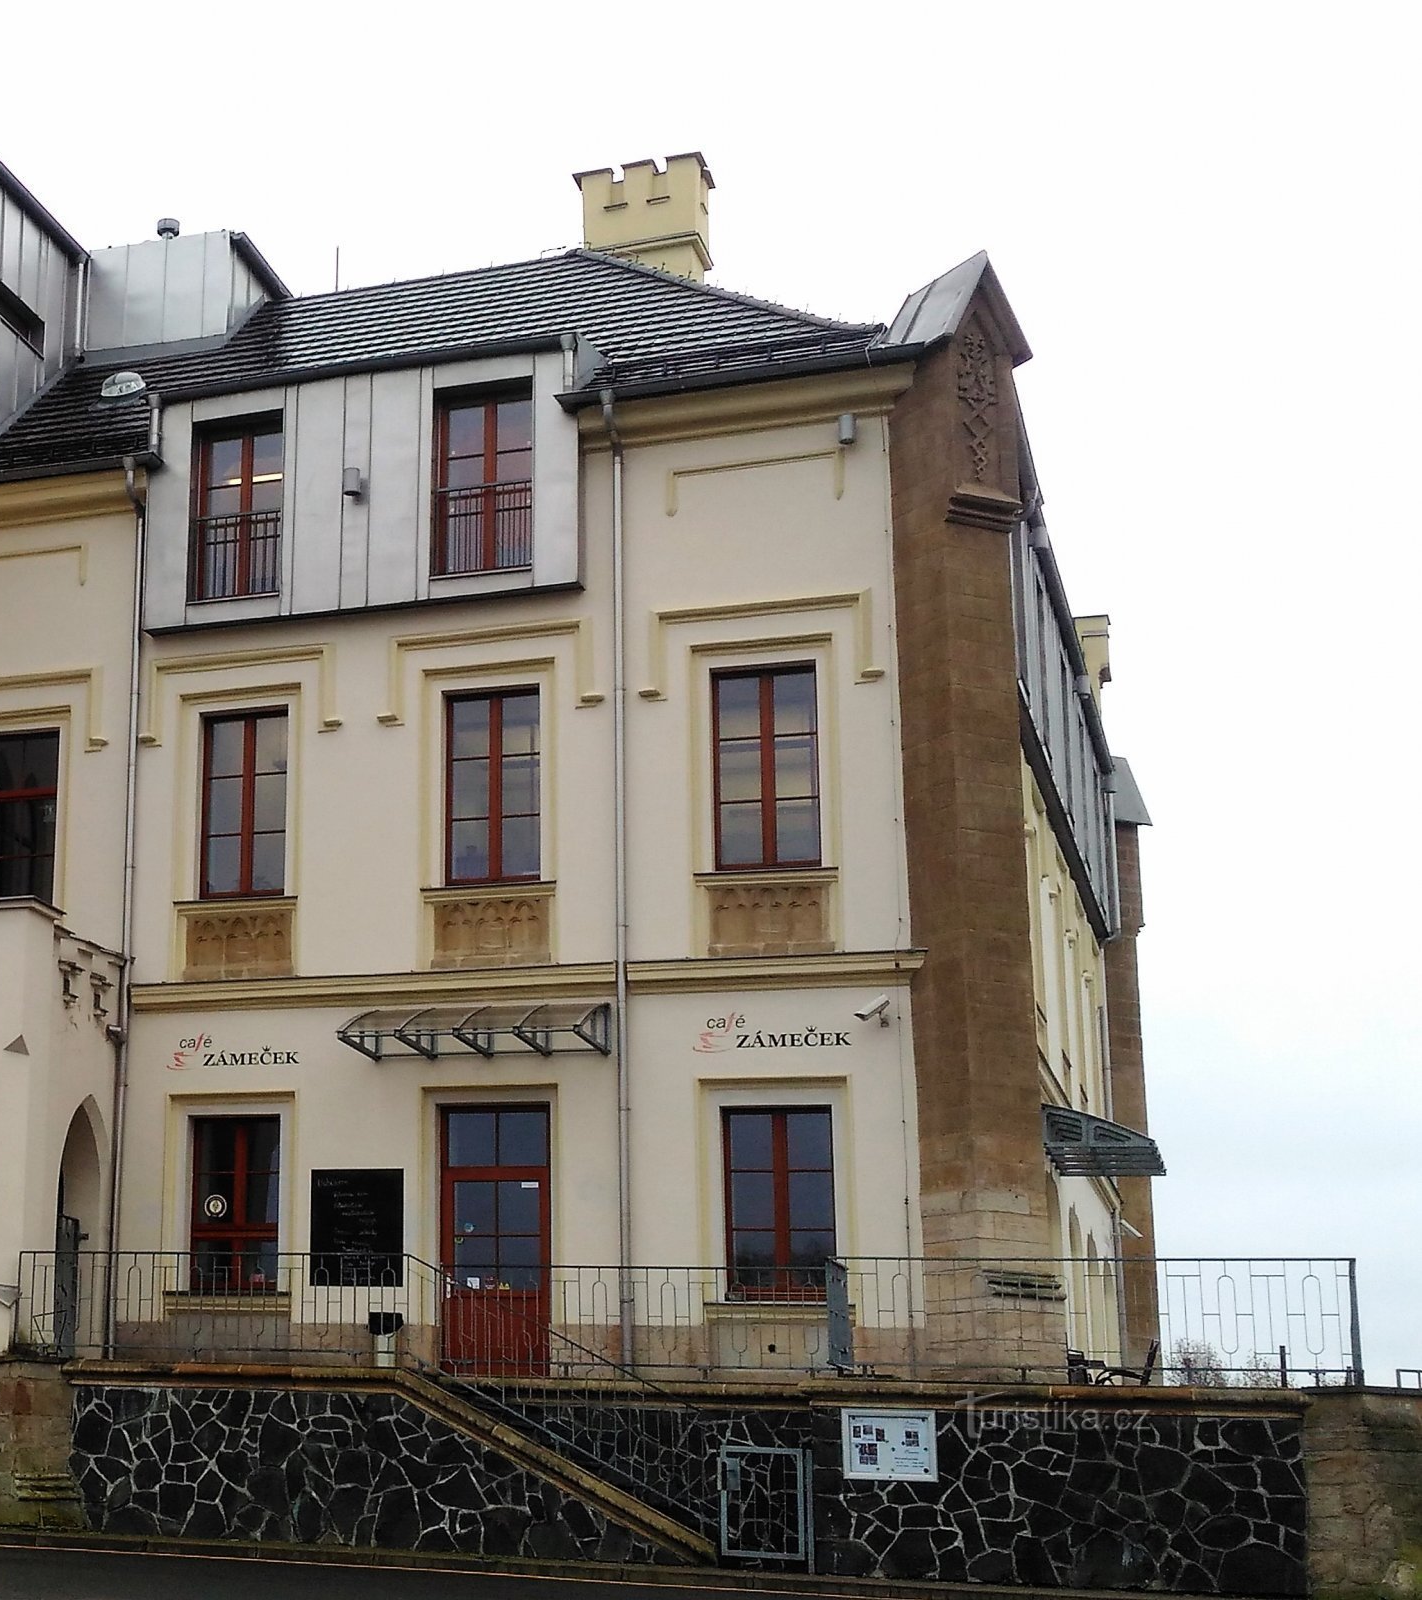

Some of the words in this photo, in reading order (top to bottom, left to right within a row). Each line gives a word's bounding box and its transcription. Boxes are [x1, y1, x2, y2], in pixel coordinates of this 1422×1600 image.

[706, 1011, 747, 1033] café
[179, 1032, 213, 1052] café
[735, 1025, 852, 1049] ZÁMEČEK
[202, 1045, 300, 1067] ZÁMEČEK
